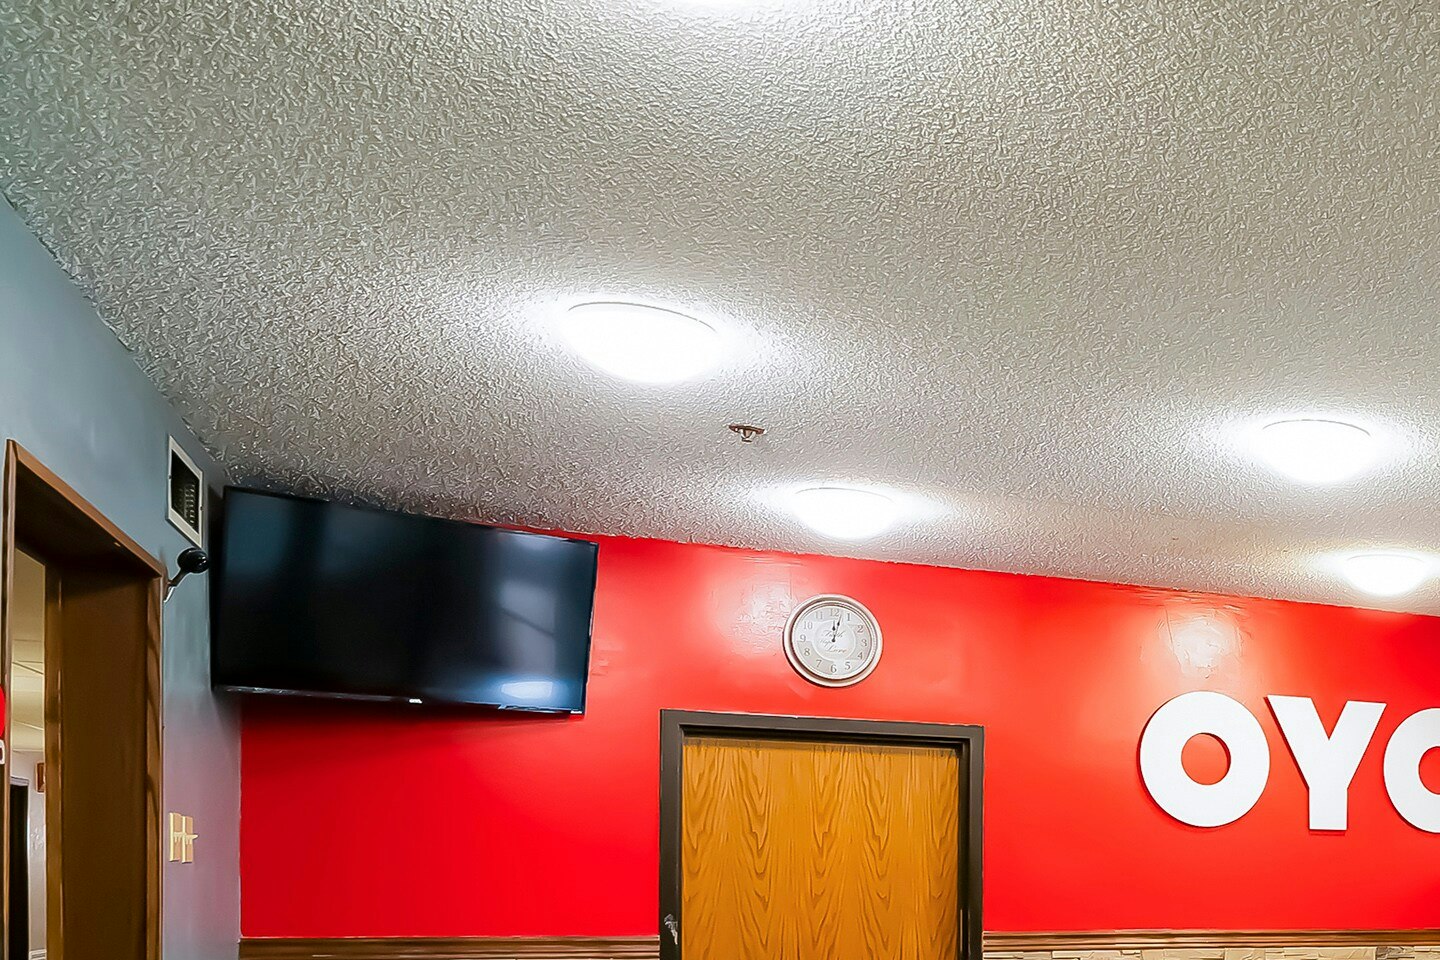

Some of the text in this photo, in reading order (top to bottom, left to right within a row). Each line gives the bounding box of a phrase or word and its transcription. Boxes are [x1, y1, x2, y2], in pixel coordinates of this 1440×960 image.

[829, 608, 840, 617] 12
[847, 613, 852, 621] 1
[803, 621, 813, 630] 10
[857, 625, 863, 633] 2
[800, 634, 807, 643] 9
[861, 639, 867, 647] 3
[803, 647, 810, 656] 8
[857, 651, 863, 660] 4
[816, 659, 822, 668] 7
[845, 661, 851, 670] 5
[830, 664, 837, 673] 6
